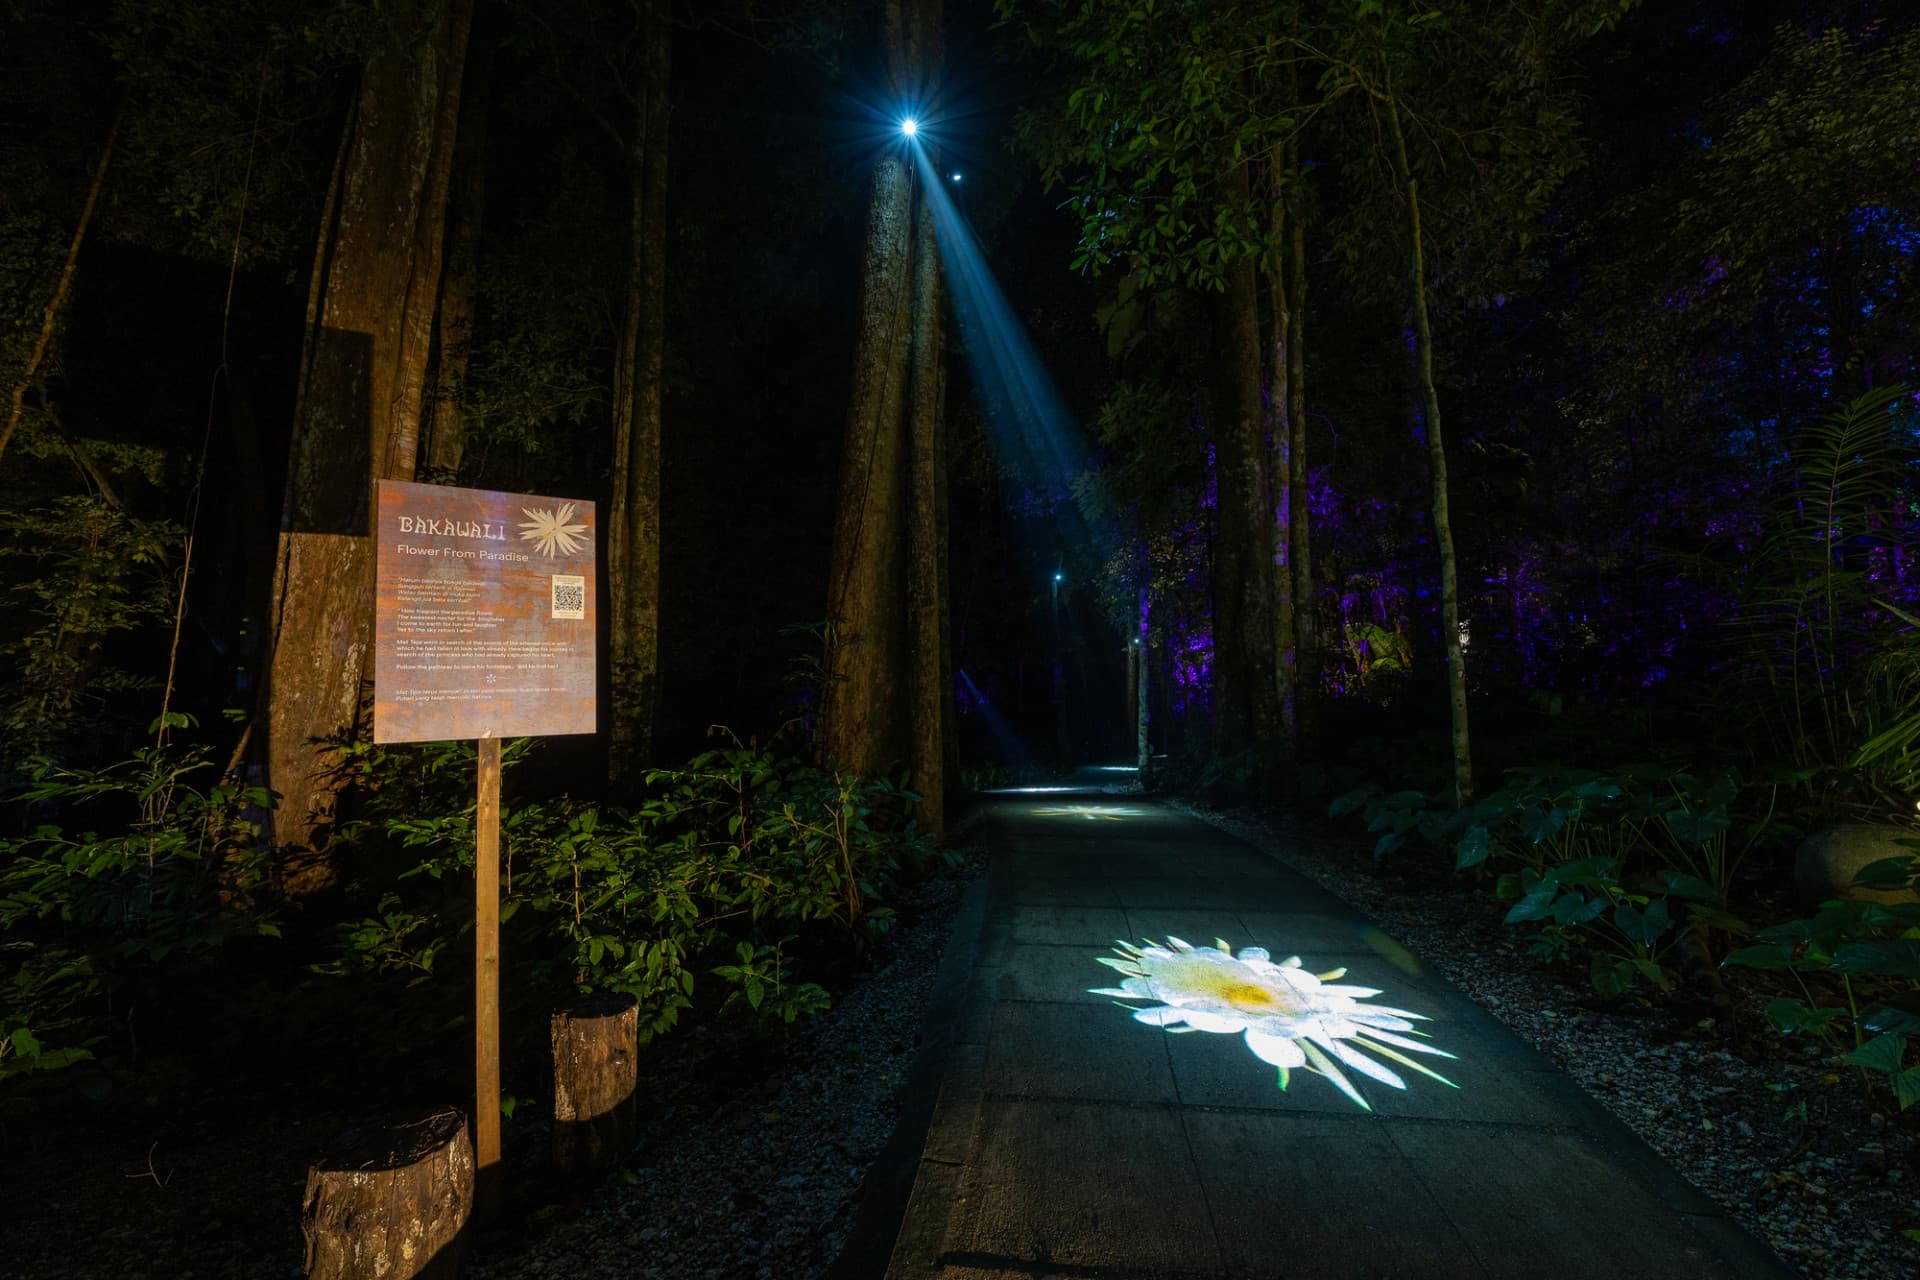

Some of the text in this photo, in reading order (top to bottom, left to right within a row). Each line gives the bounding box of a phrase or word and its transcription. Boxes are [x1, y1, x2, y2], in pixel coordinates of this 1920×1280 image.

[398, 515, 506, 541] BAKAWALI
[397, 544, 529, 562] Flower From Paradise
